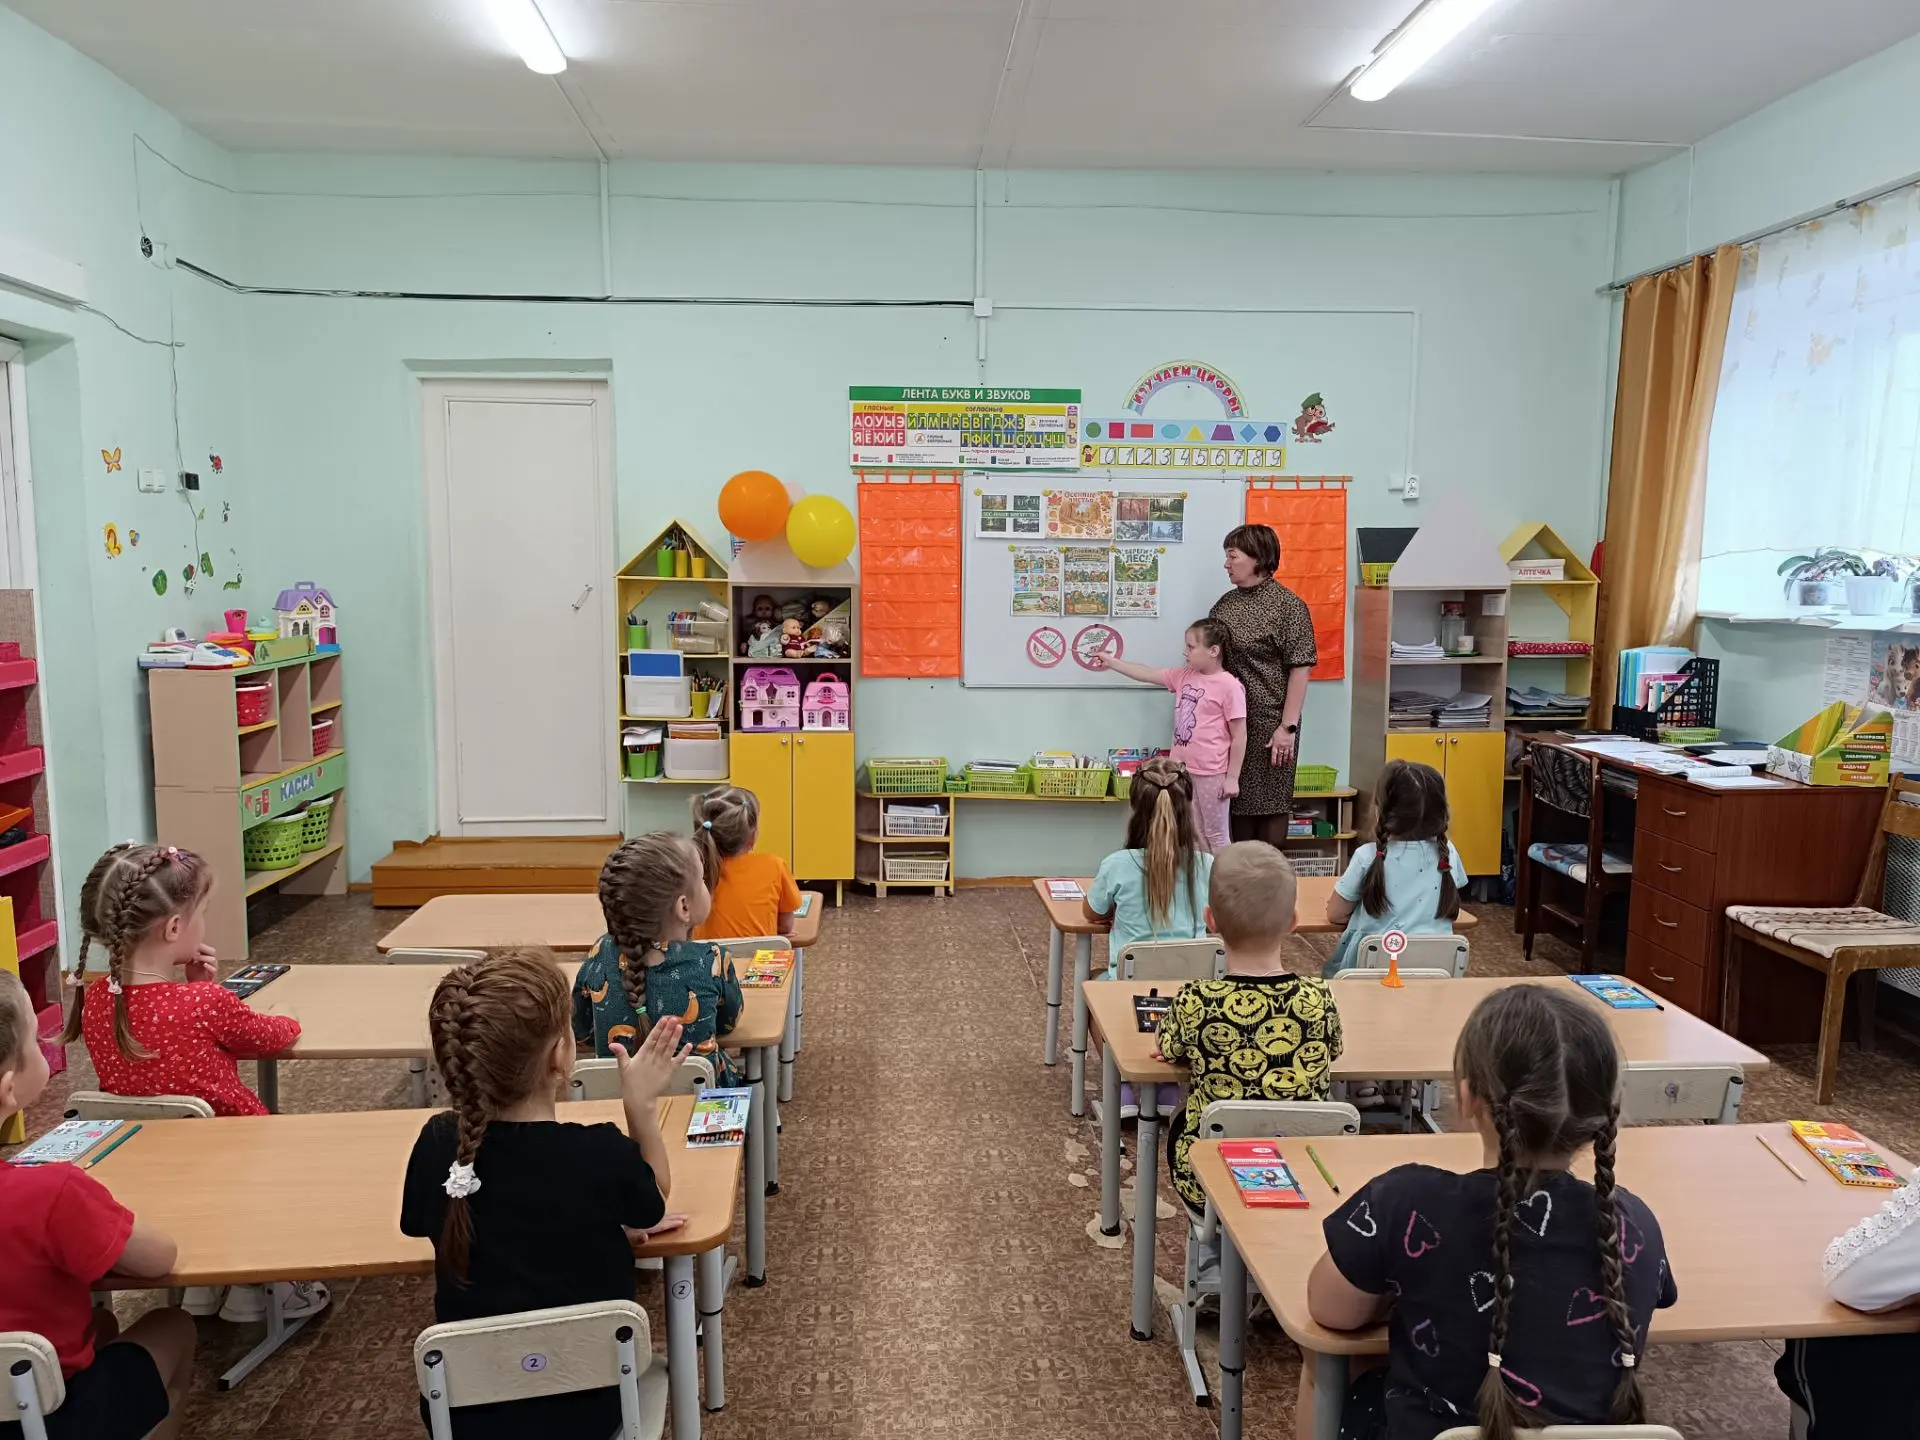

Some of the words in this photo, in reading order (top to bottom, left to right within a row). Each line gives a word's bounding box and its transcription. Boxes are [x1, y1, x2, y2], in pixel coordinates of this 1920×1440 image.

[1133, 365, 1192, 404] ИЗУЧАЕМ
[1196, 367, 1240, 412] ЦИФРЫ
[902, 388, 938, 399] ЛЕНТА
[941, 388, 971, 399] БУКВ
[974, 389, 983, 400] И
[986, 389, 1031, 401] ЗВУКОВ
[1518, 568, 1552, 576] АПТЕЧКА
[280, 772, 315, 802] КАССА
[678, 1285, 686, 1295] 2
[529, 1358, 539, 1368] 2
